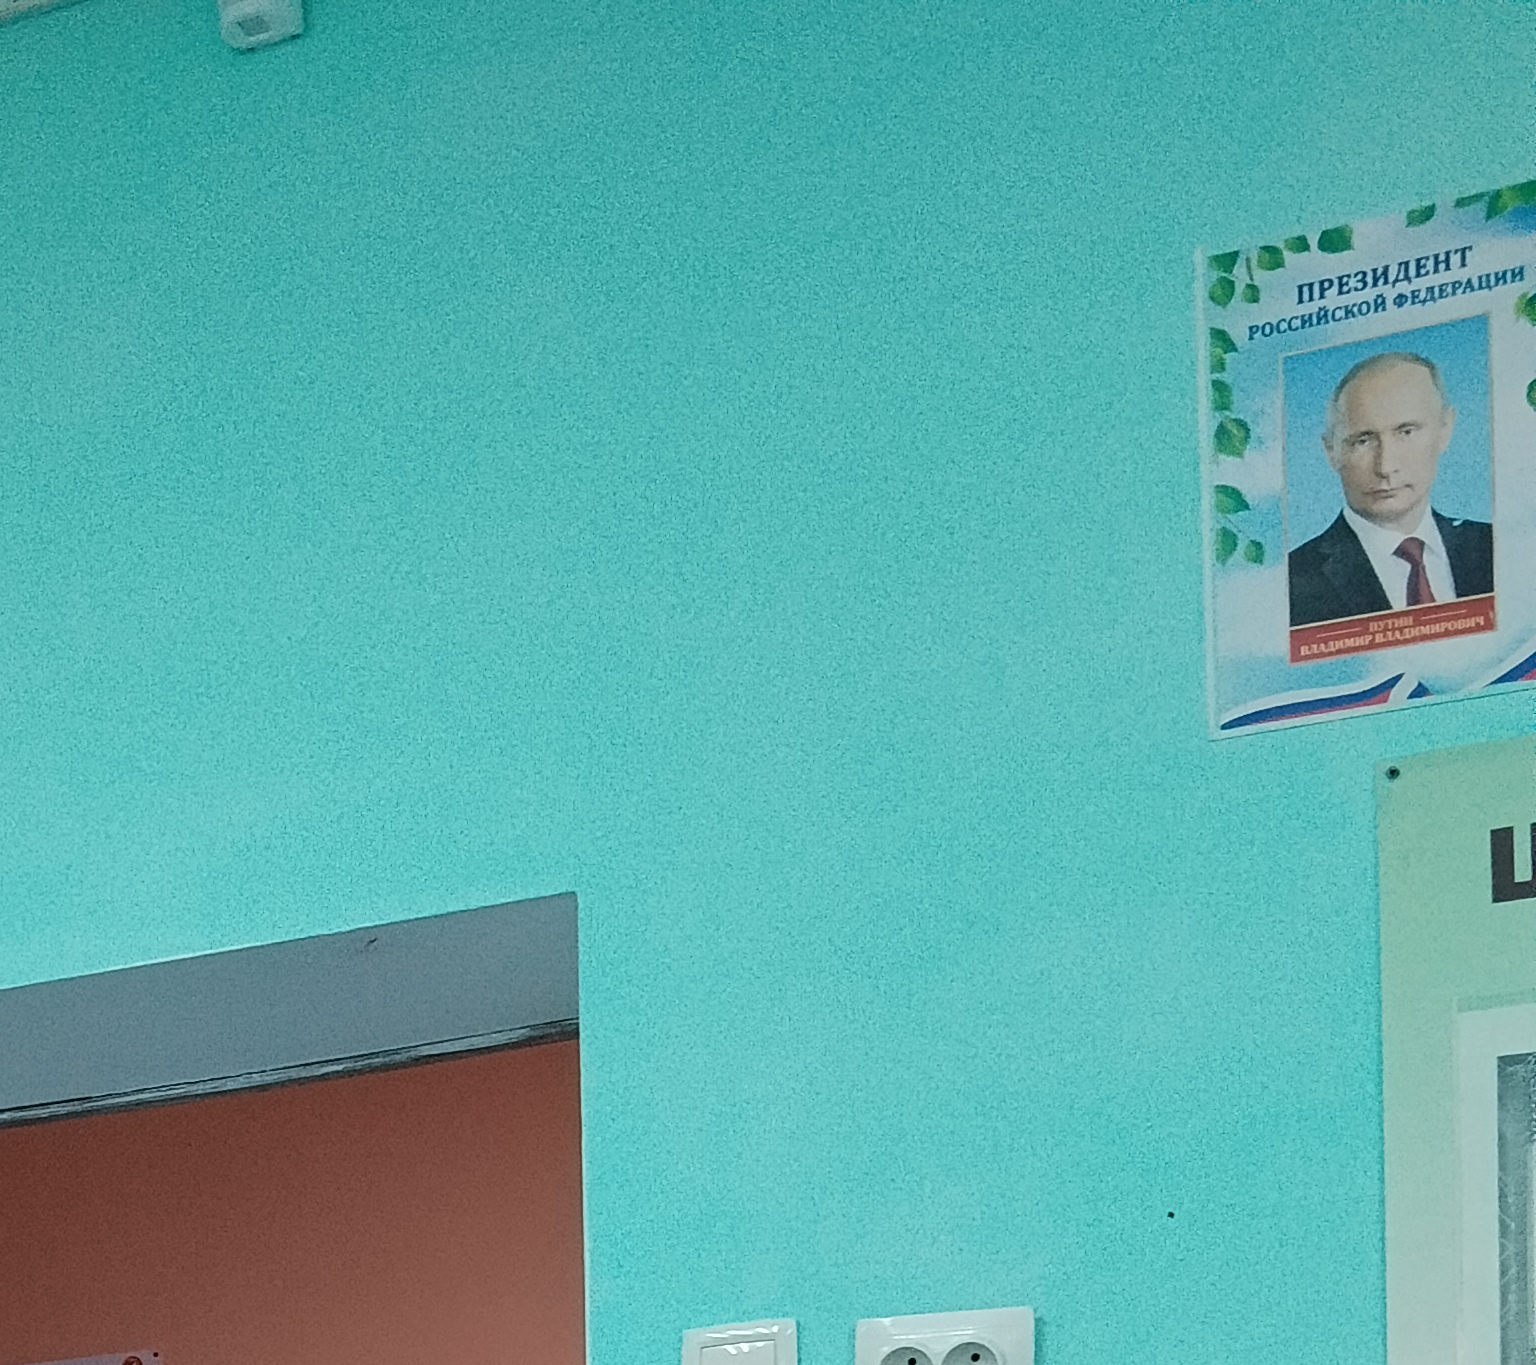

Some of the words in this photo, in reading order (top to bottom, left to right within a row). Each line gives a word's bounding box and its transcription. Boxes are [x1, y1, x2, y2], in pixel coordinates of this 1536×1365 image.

[1296, 245, 1473, 305] ПРЕЗИДЕНТ
[1248, 294, 1387, 341] РОССИЙСКОЙ
[1393, 265, 1526, 310] ФЕДЕРАЦИИ
[1300, 635, 1373, 656] ВЛАДИМИР
[1375, 616, 1485, 644] ВЛАДИМИРОВИЧ
[1369, 615, 1413, 632] ПУТИН
